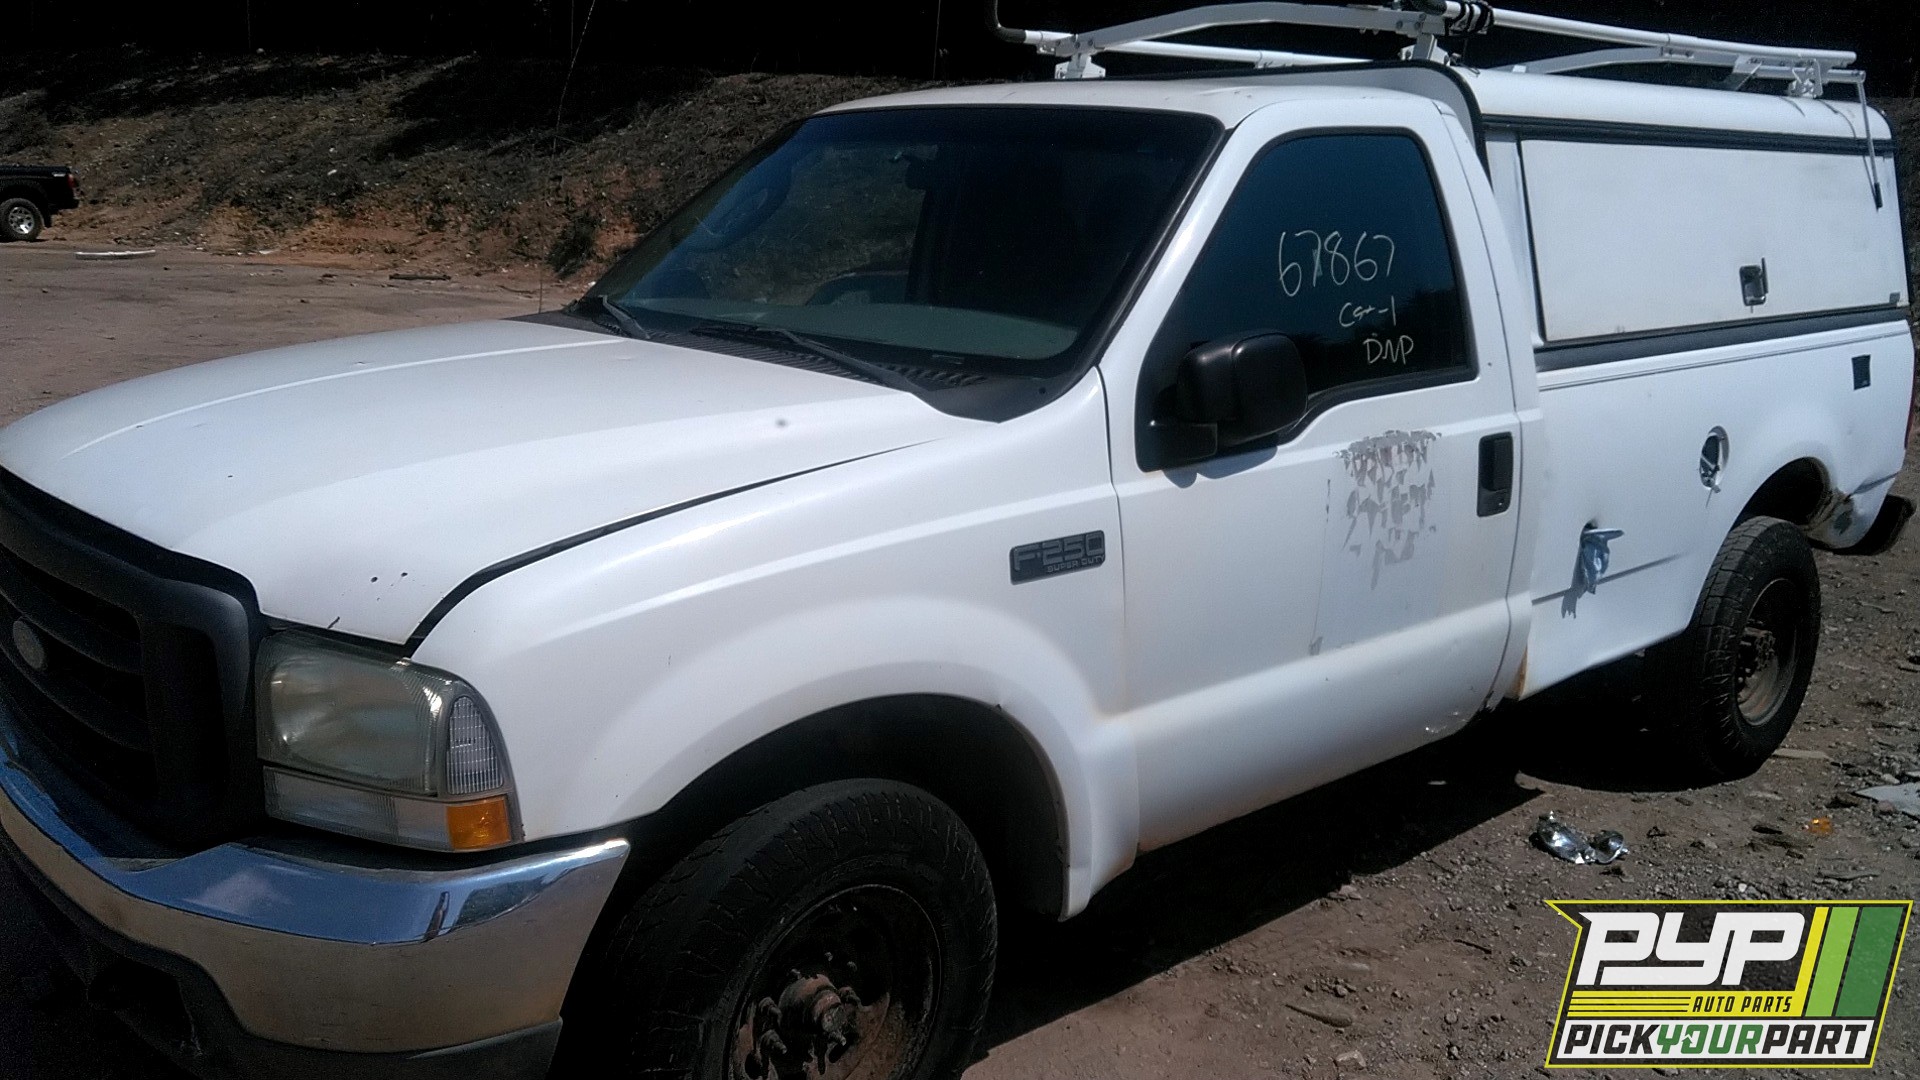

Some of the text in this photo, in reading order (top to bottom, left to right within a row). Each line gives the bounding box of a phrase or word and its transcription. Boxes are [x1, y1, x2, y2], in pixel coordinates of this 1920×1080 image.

[1278, 229, 1395, 297] 67867
[1362, 334, 1414, 365] DNP
[1047, 554, 1105, 573] SUPER DUTY
